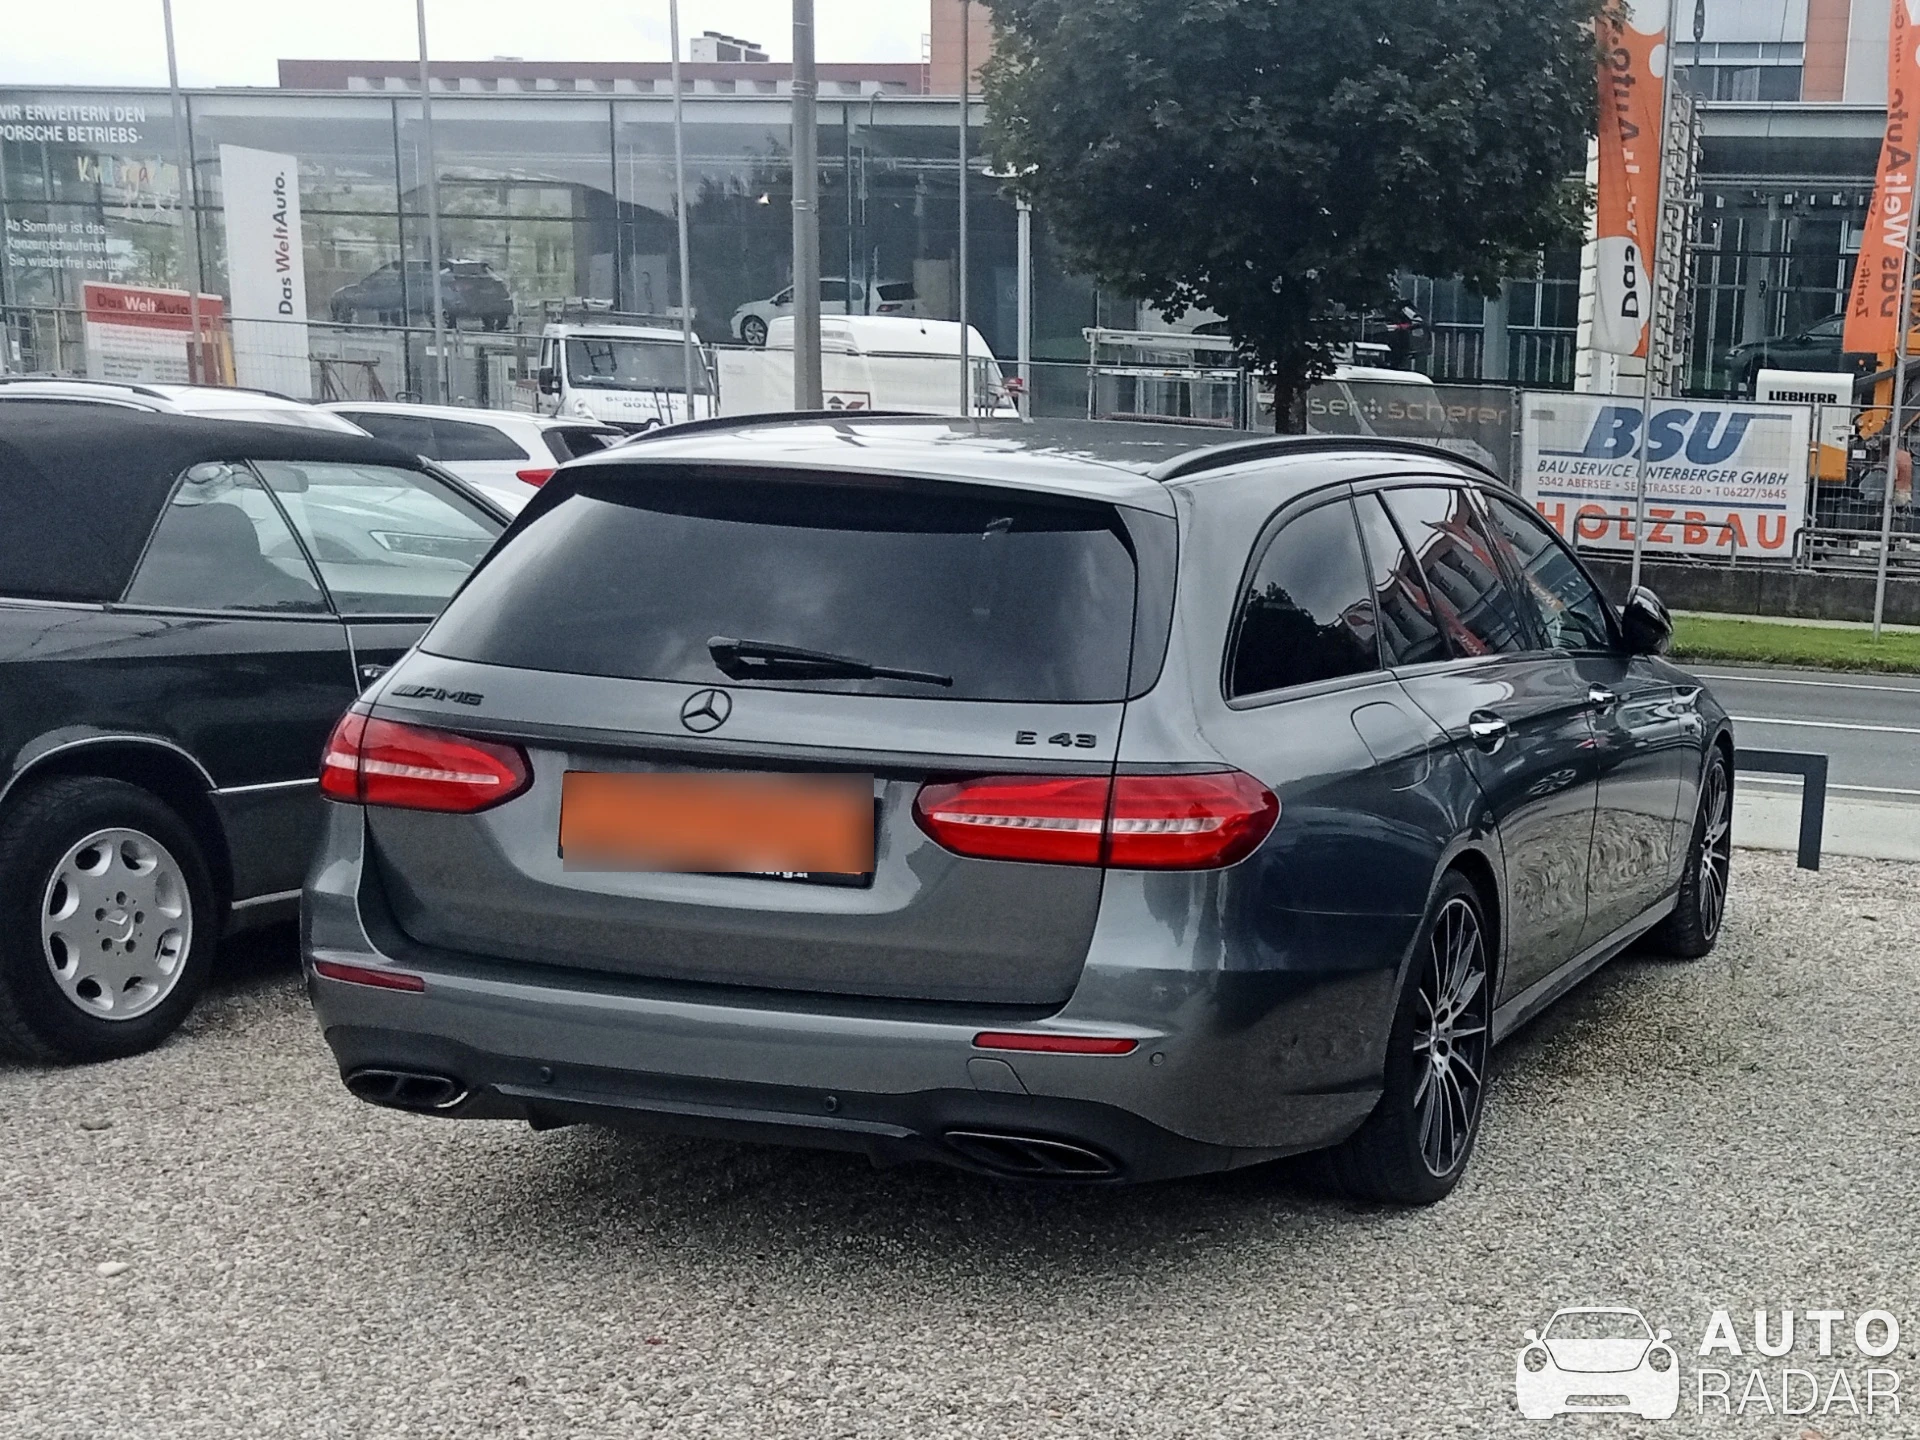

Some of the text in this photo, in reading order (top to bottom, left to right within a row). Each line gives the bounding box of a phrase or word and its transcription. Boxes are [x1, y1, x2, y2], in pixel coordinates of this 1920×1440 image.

[25, 105, 111, 121] ERWEITERN
[115, 106, 146, 122] DEN
[67, 126, 144, 143] BETRIEBS-
[6, 219, 105, 235] Ab Sommer ist das
[7, 237, 112, 253] Konzernschaufenst
[273, 171, 293, 315] Das WeltAuto.
[8, 253, 26, 267] Sie
[28, 255, 63, 269] wieder
[65, 256, 84, 269] frei
[1768, 390, 1838, 404] LIEBHERR
[1387, 398, 1507, 425] scherer
[1583, 406, 1754, 465] BSU
[1537, 459, 1569, 473] BAU
[1571, 462, 1633, 477] SERVICE
[1740, 470, 1789, 486] GMBH
[1537, 476, 1787, 499] 5342 ABERSEE SESTRASSE 20 T 06227/3645
[1536, 501, 1787, 550] HOLZBAU
[410, 685, 485, 706] AMG
[1015, 730, 1097, 749] E 43
